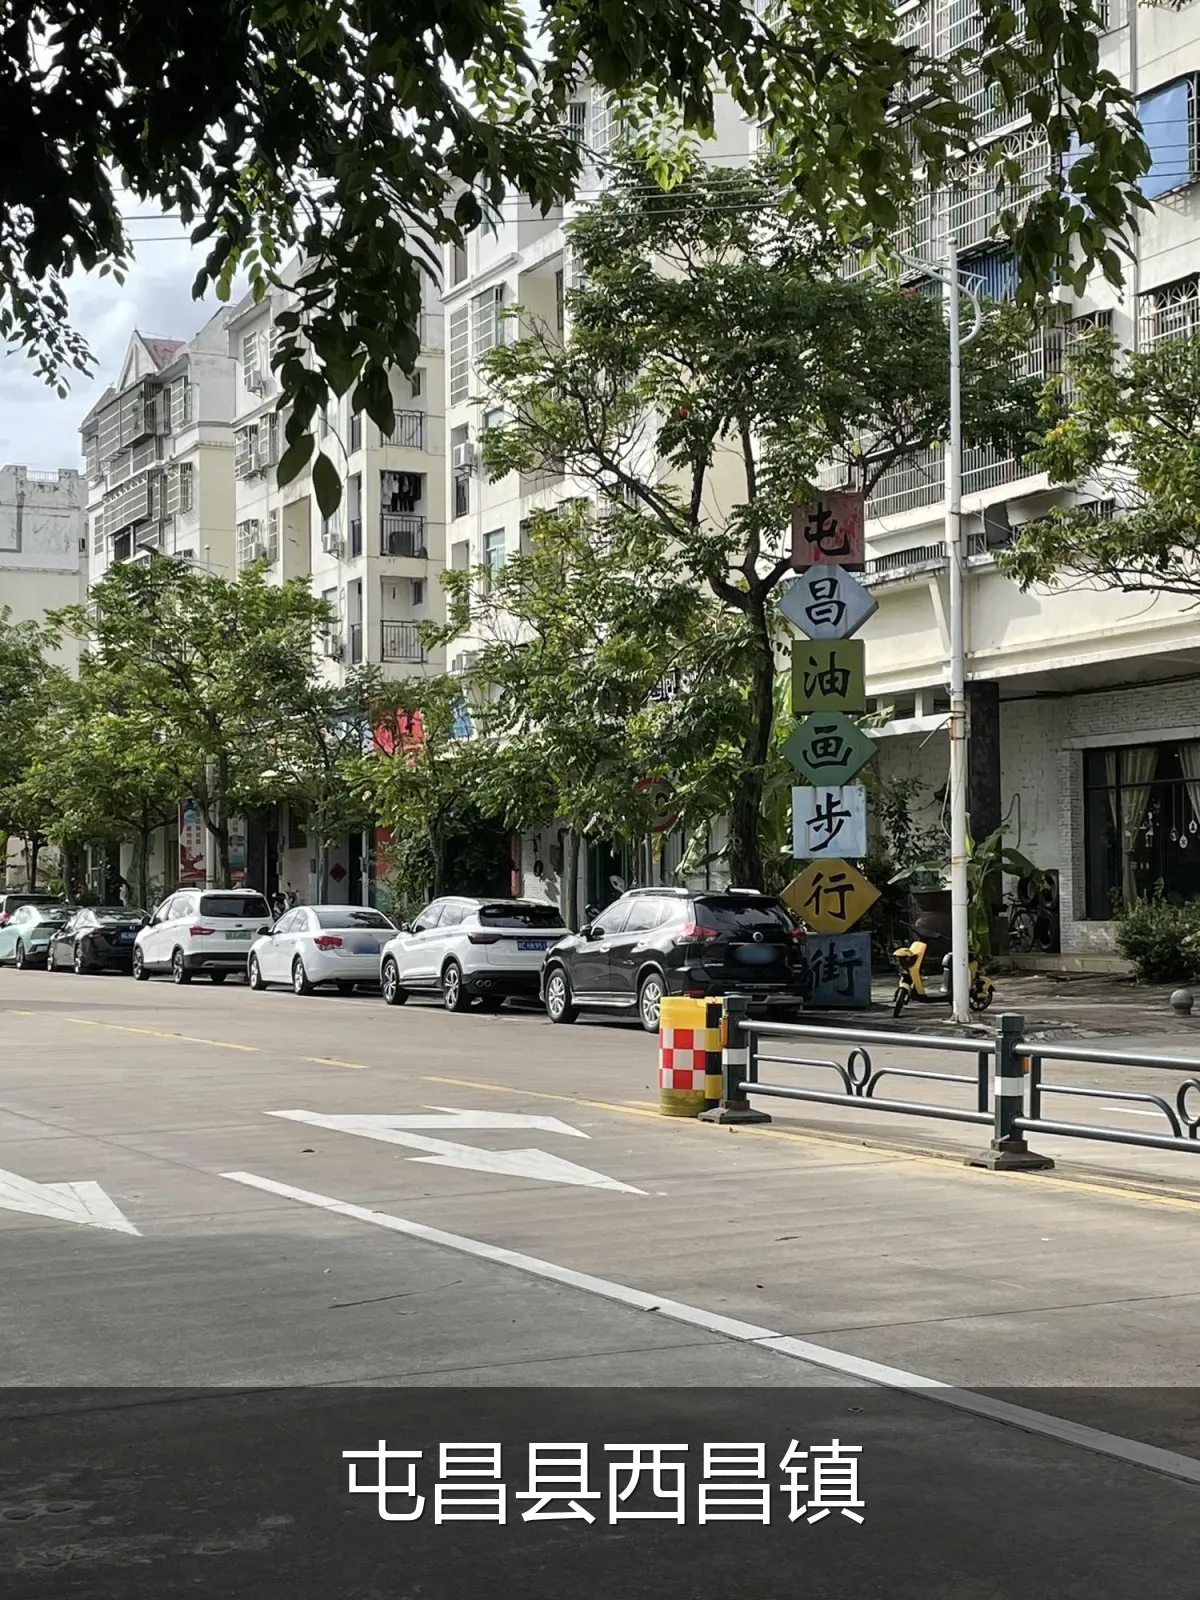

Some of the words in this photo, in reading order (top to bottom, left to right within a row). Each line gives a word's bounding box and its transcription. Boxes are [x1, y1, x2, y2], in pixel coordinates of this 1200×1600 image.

[802, 501, 863, 996] 屯昌油画步行街
